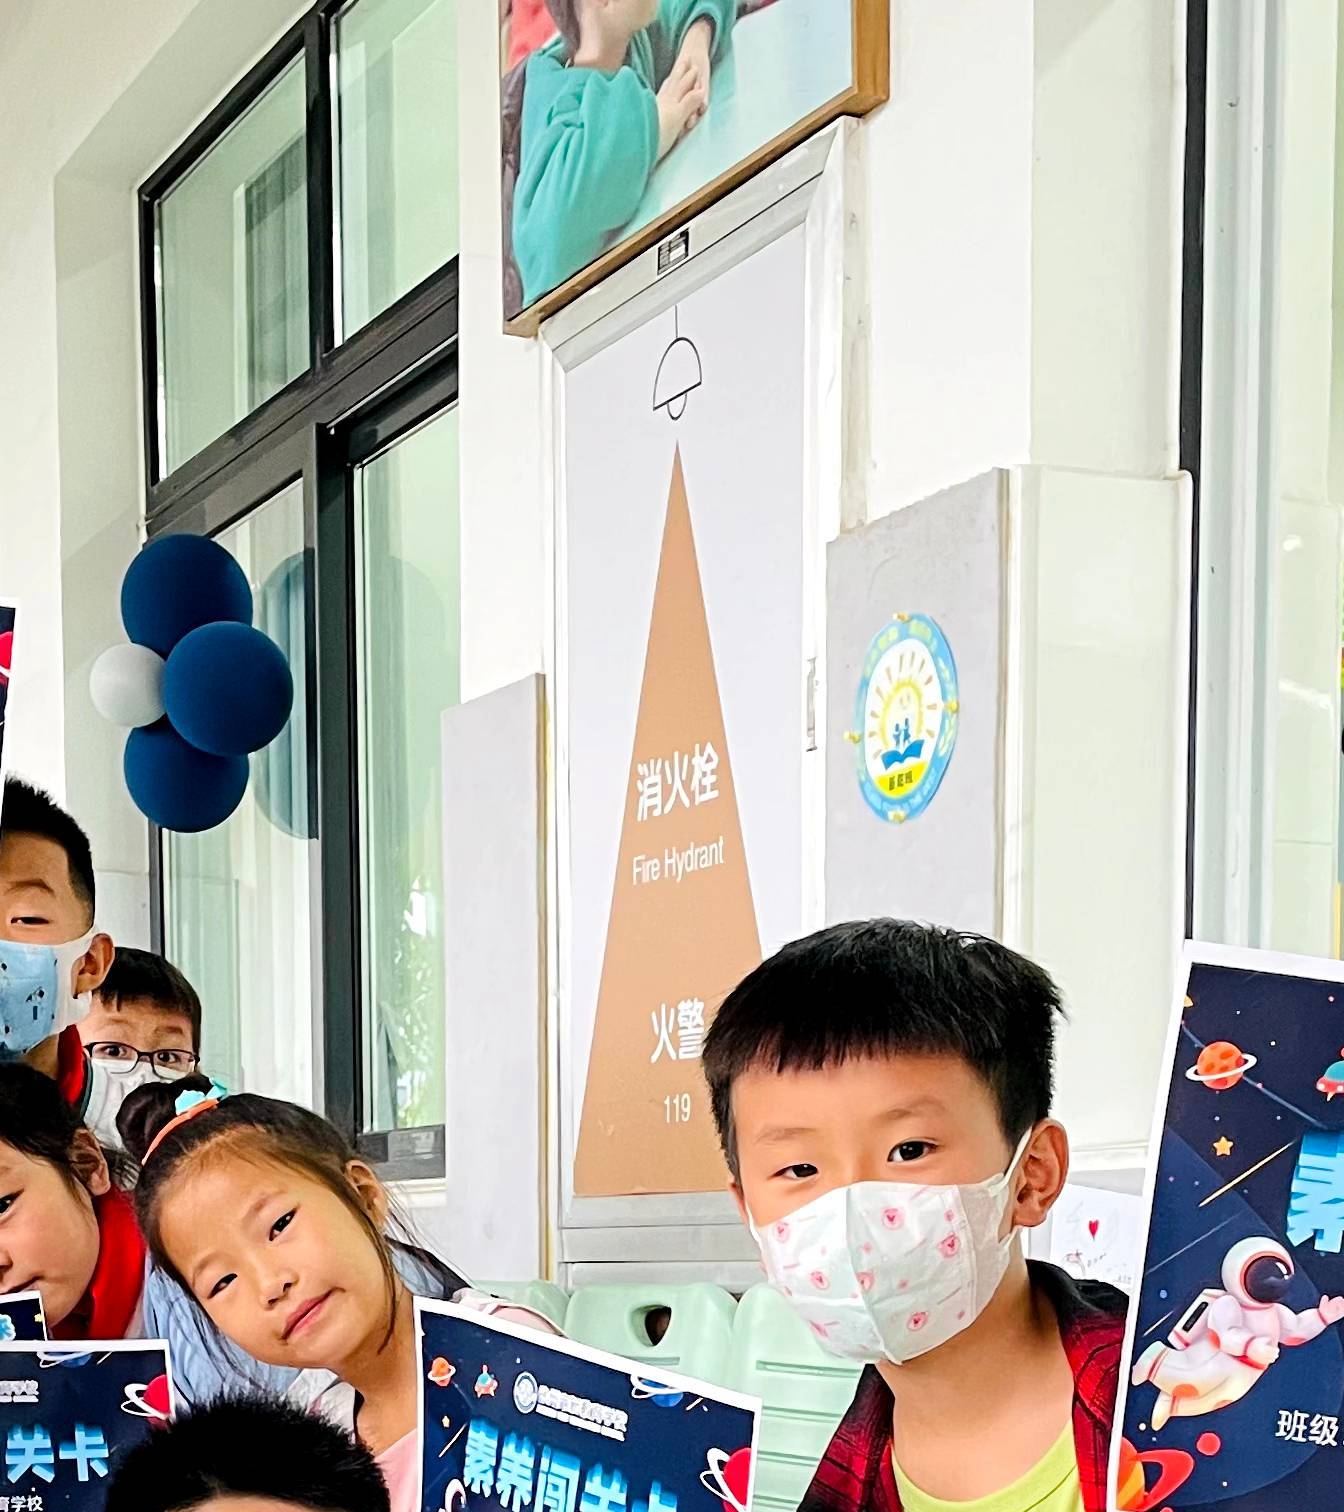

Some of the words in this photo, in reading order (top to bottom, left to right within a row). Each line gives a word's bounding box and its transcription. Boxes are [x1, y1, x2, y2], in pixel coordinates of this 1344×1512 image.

[637, 742, 719, 822] 消火栓
[633, 855, 660, 885] Fire
[664, 835, 724, 883] Hydrant
[650, 998, 704, 1064] 火警
[663, 1093, 691, 1124] 119
